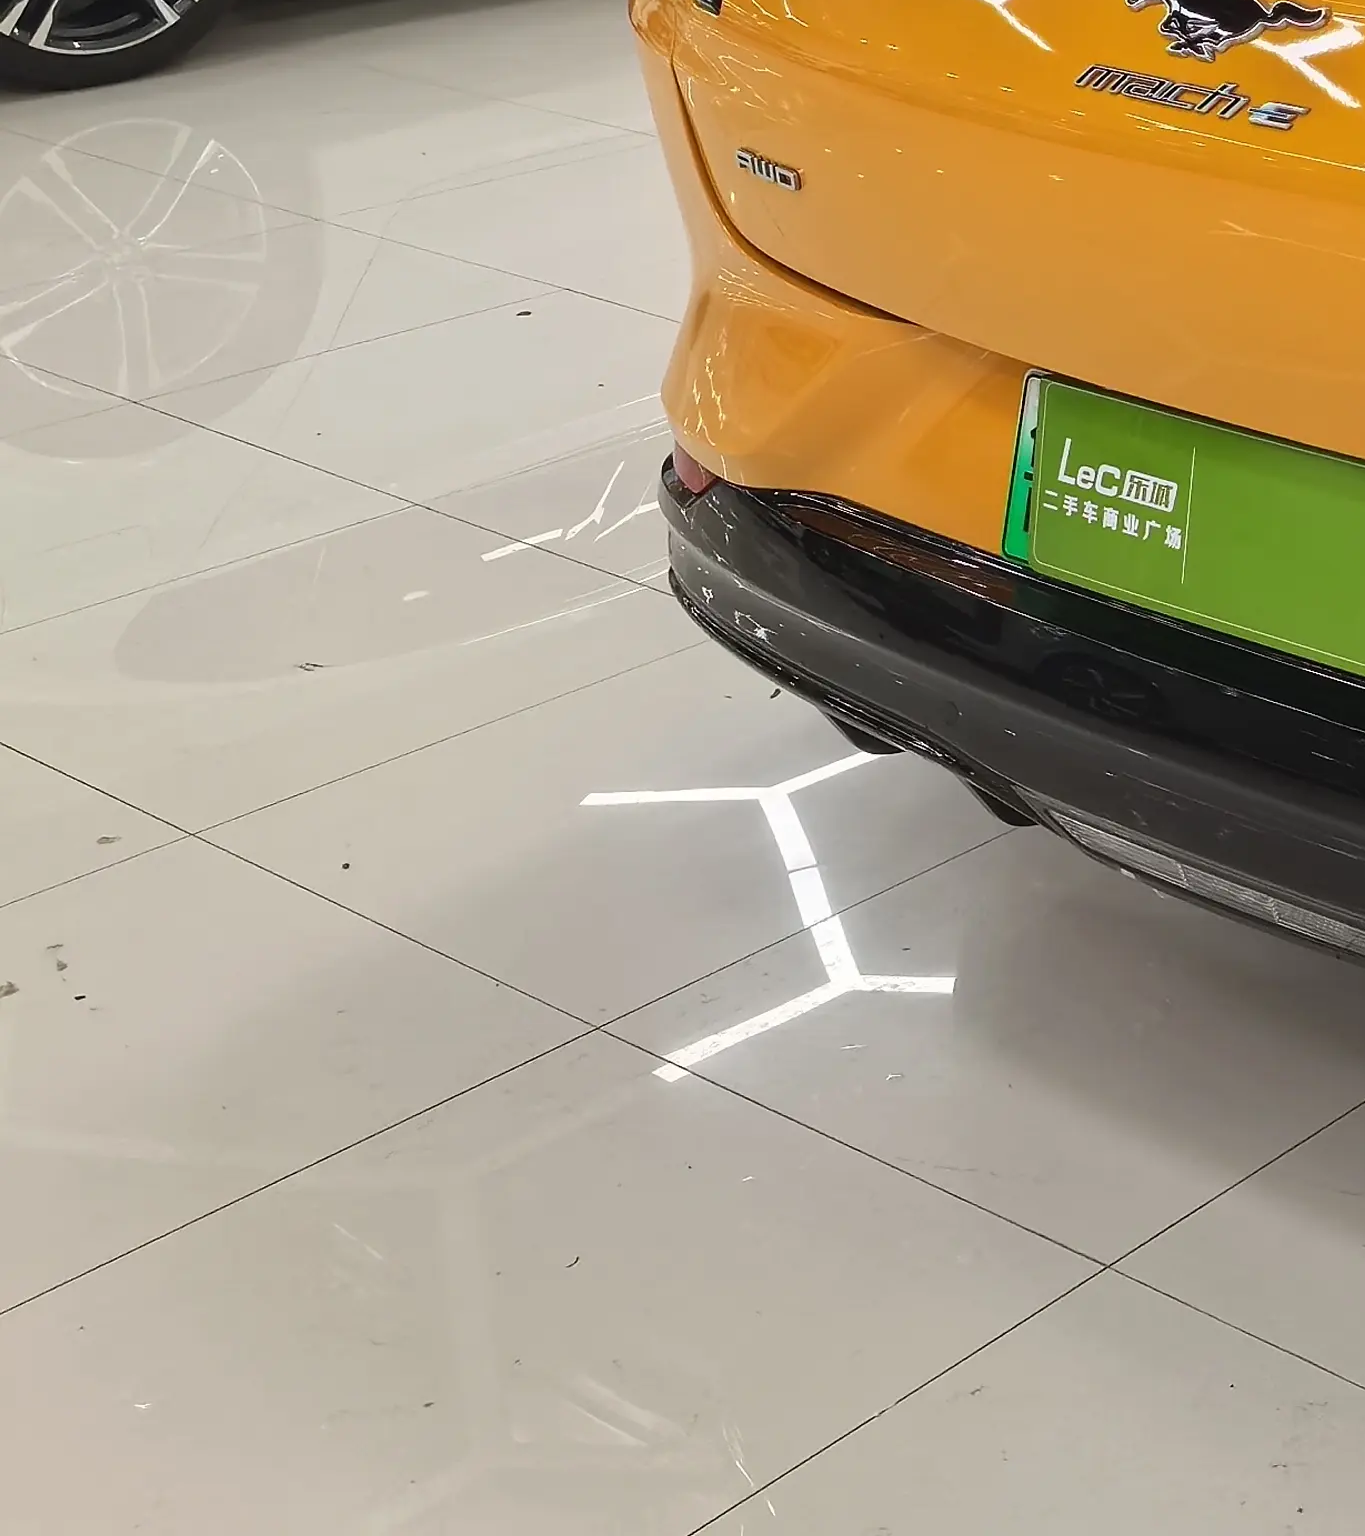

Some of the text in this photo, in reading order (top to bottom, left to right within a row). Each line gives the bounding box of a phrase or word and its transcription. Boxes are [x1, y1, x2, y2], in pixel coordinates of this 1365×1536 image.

[1042, 489, 1183, 550] 二手车商业广场
